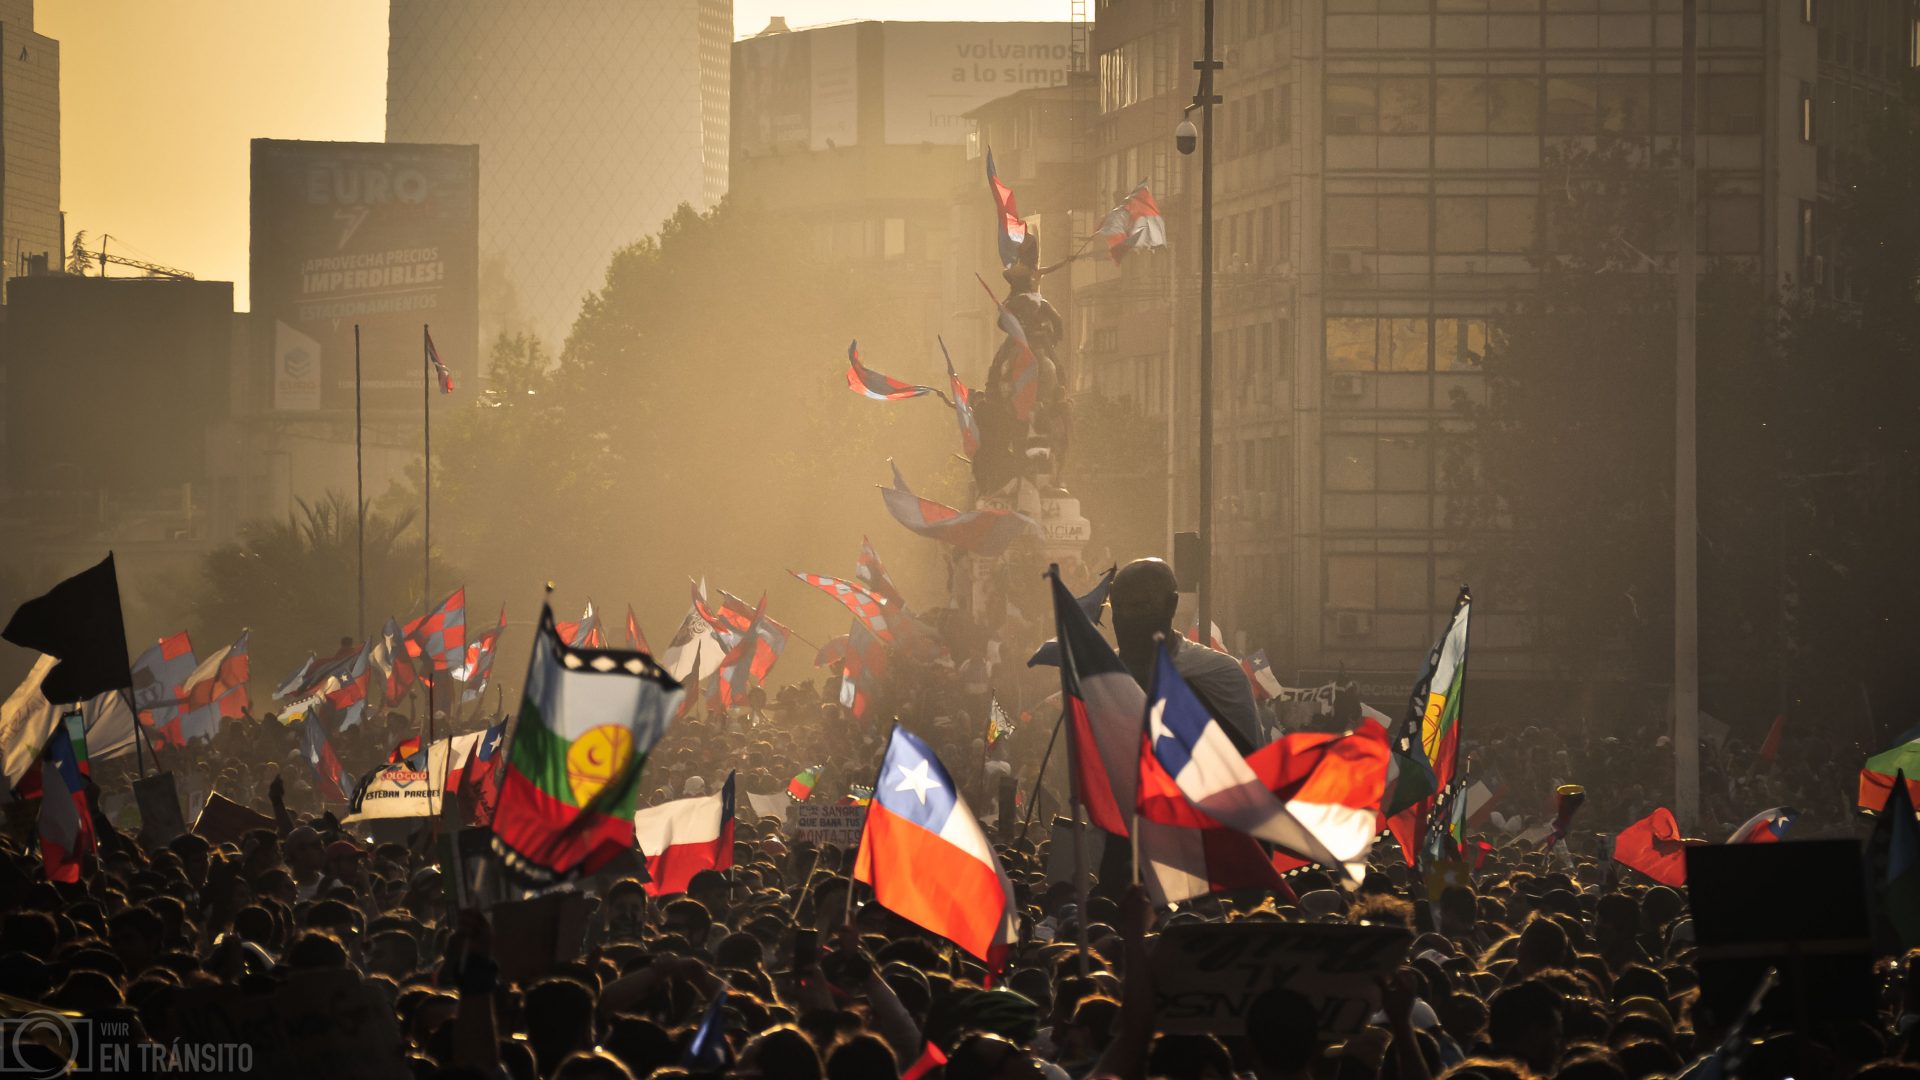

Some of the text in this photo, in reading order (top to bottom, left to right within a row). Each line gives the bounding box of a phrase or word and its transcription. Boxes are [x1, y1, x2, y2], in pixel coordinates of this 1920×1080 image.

[957, 38, 1079, 60] volvamos
[952, 62, 1070, 87] a lo simp
[306, 167, 428, 205] EURO
[386, 247, 439, 266] PRECIOS
[303, 262, 444, 294] IMPERDIBLES!
[300, 294, 437, 320] ESTACIONAMIENTOS
[365, 790, 400, 801] ESTEBAN
[822, 805, 861, 817] SANGRE
[798, 817, 818, 828] QUE
[846, 817, 861, 828] TUS
